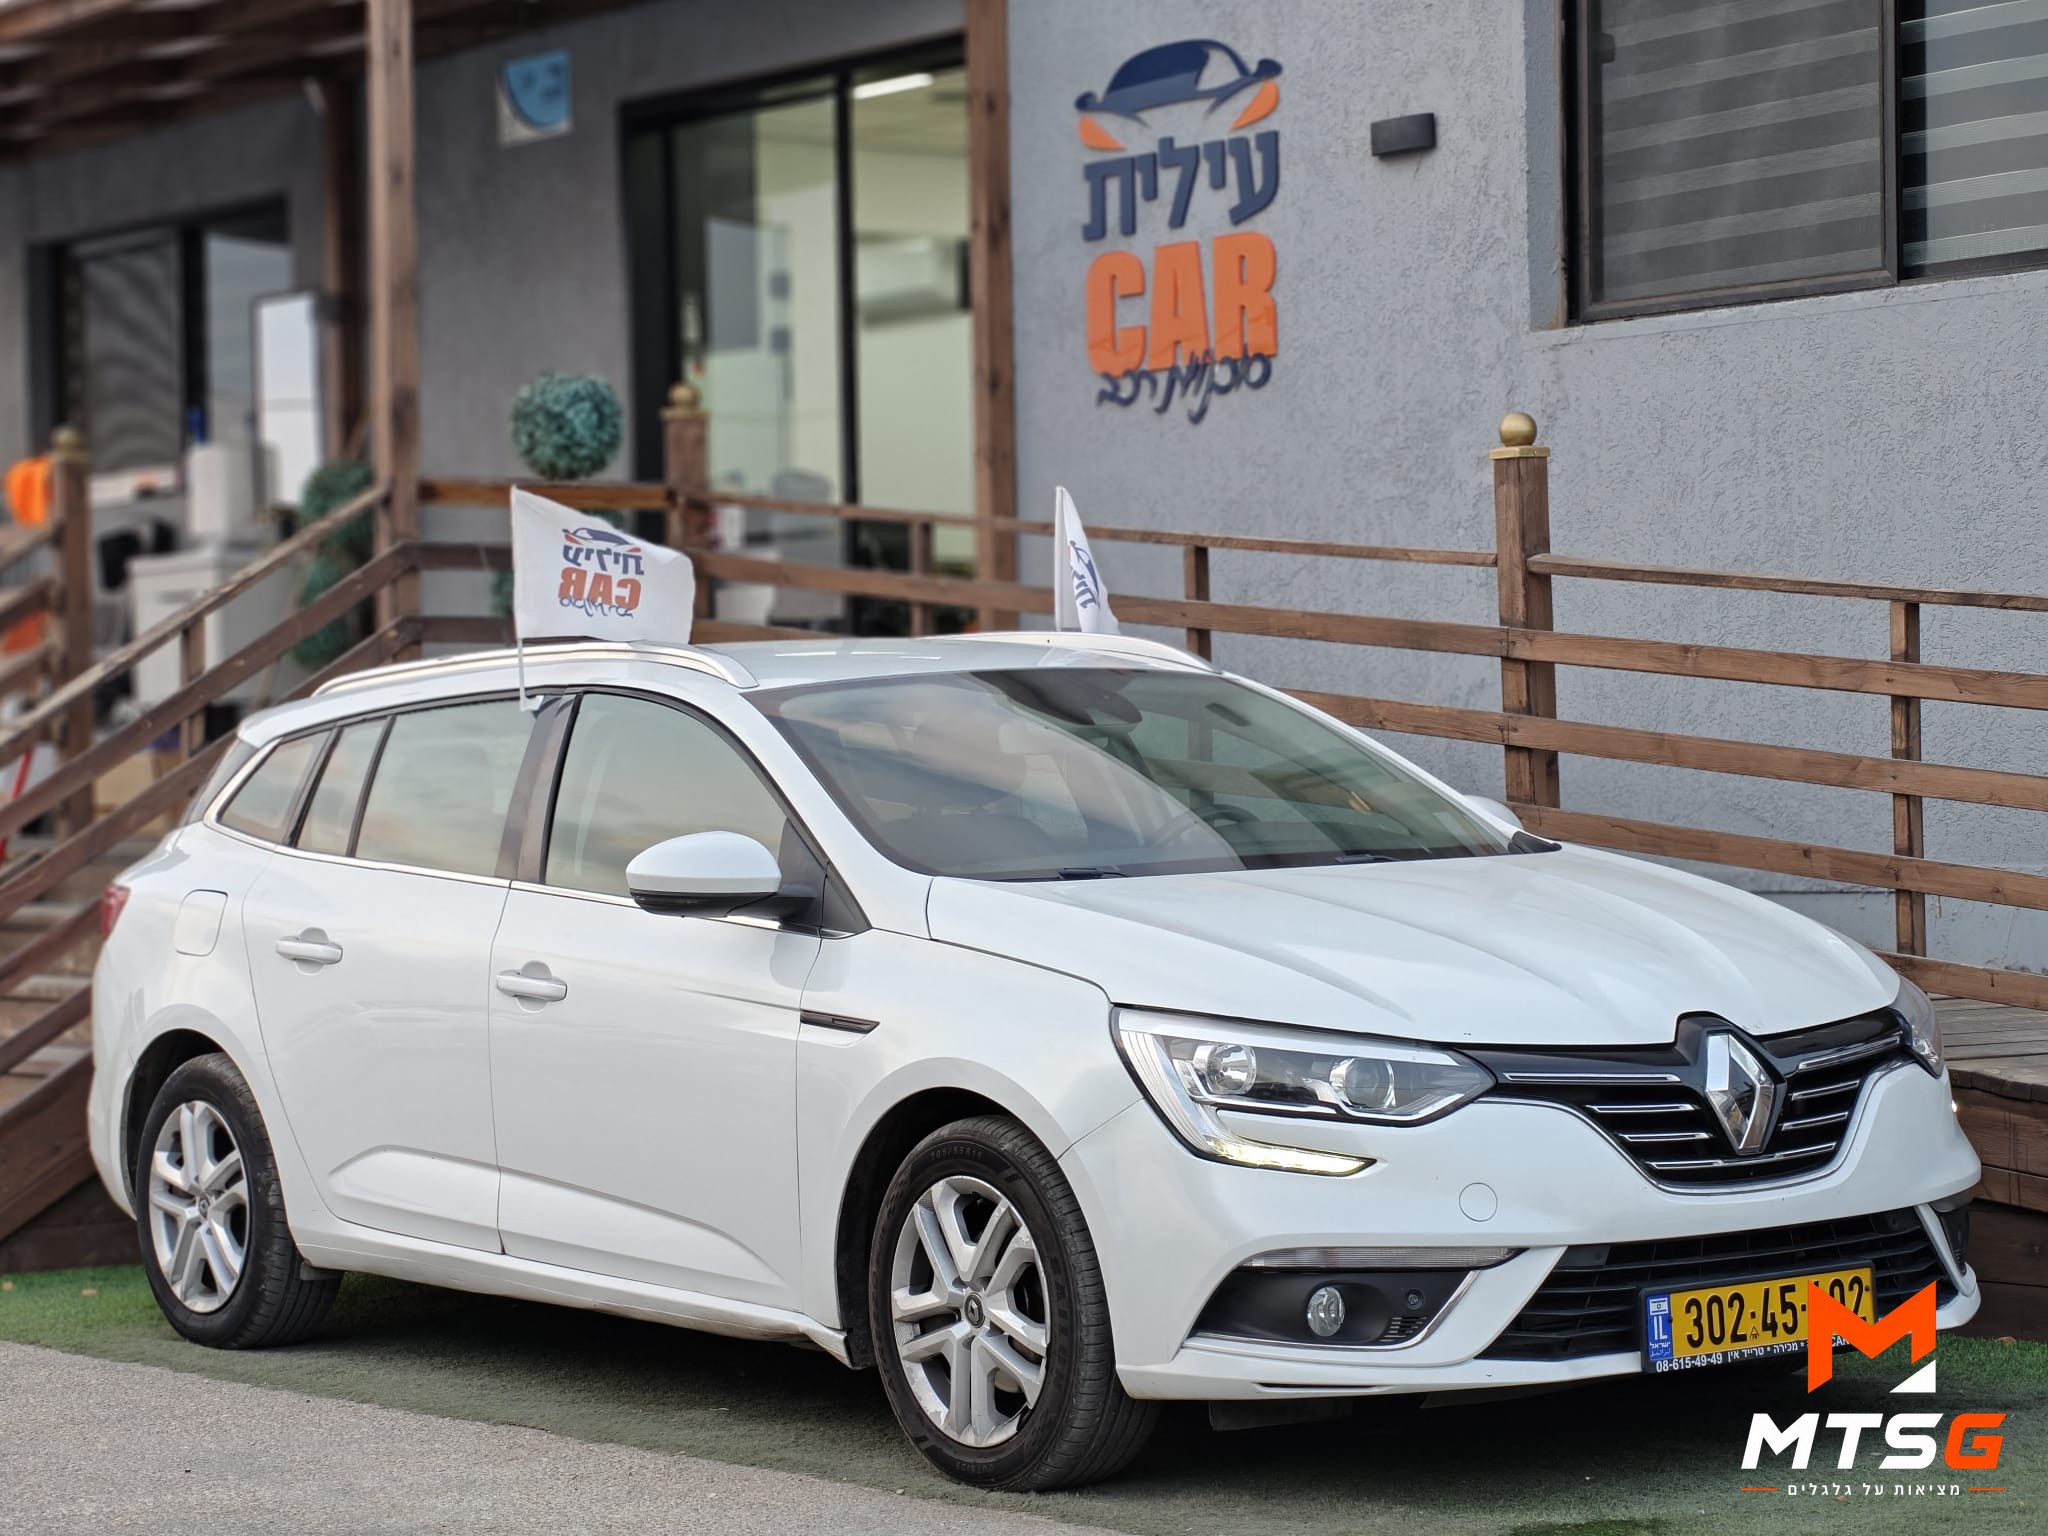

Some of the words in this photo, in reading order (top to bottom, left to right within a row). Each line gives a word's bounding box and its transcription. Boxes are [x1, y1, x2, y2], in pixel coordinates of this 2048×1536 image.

[1082, 130, 1279, 242] עילית
[1085, 231, 1278, 378] CAR
[1653, 1315, 1668, 1341] IL
[1656, 1352, 1723, 1373] 08-615-49-49
